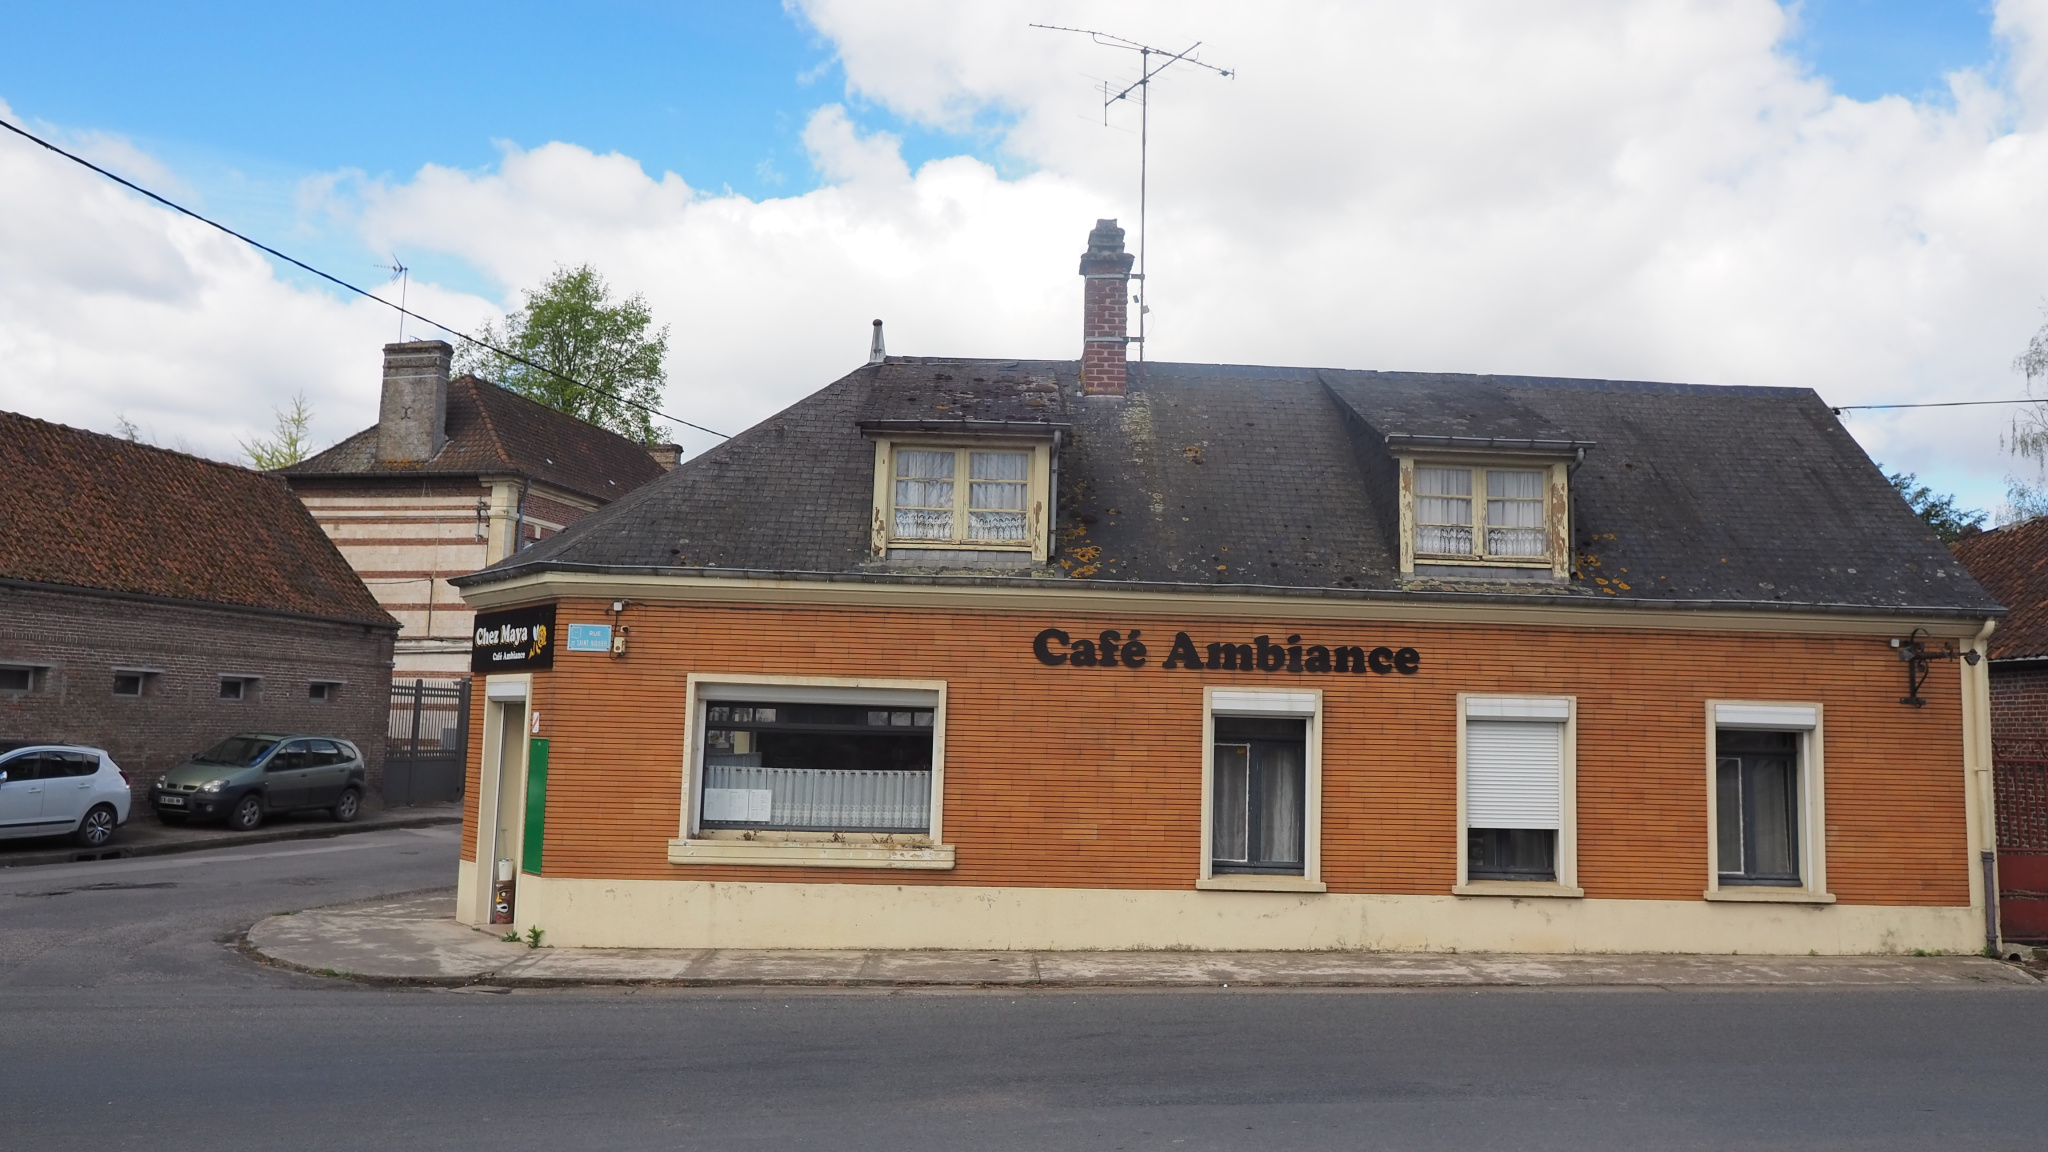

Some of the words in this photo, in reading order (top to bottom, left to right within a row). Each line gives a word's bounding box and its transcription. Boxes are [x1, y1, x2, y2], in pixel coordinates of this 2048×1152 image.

[476, 627, 499, 646] Chez
[500, 624, 528, 646] Maya
[492, 651, 503, 661] Café
[503, 651, 526, 661] Ambiance
[1033, 628, 1147, 668] Café
[1162, 631, 1421, 675] Ambiance
